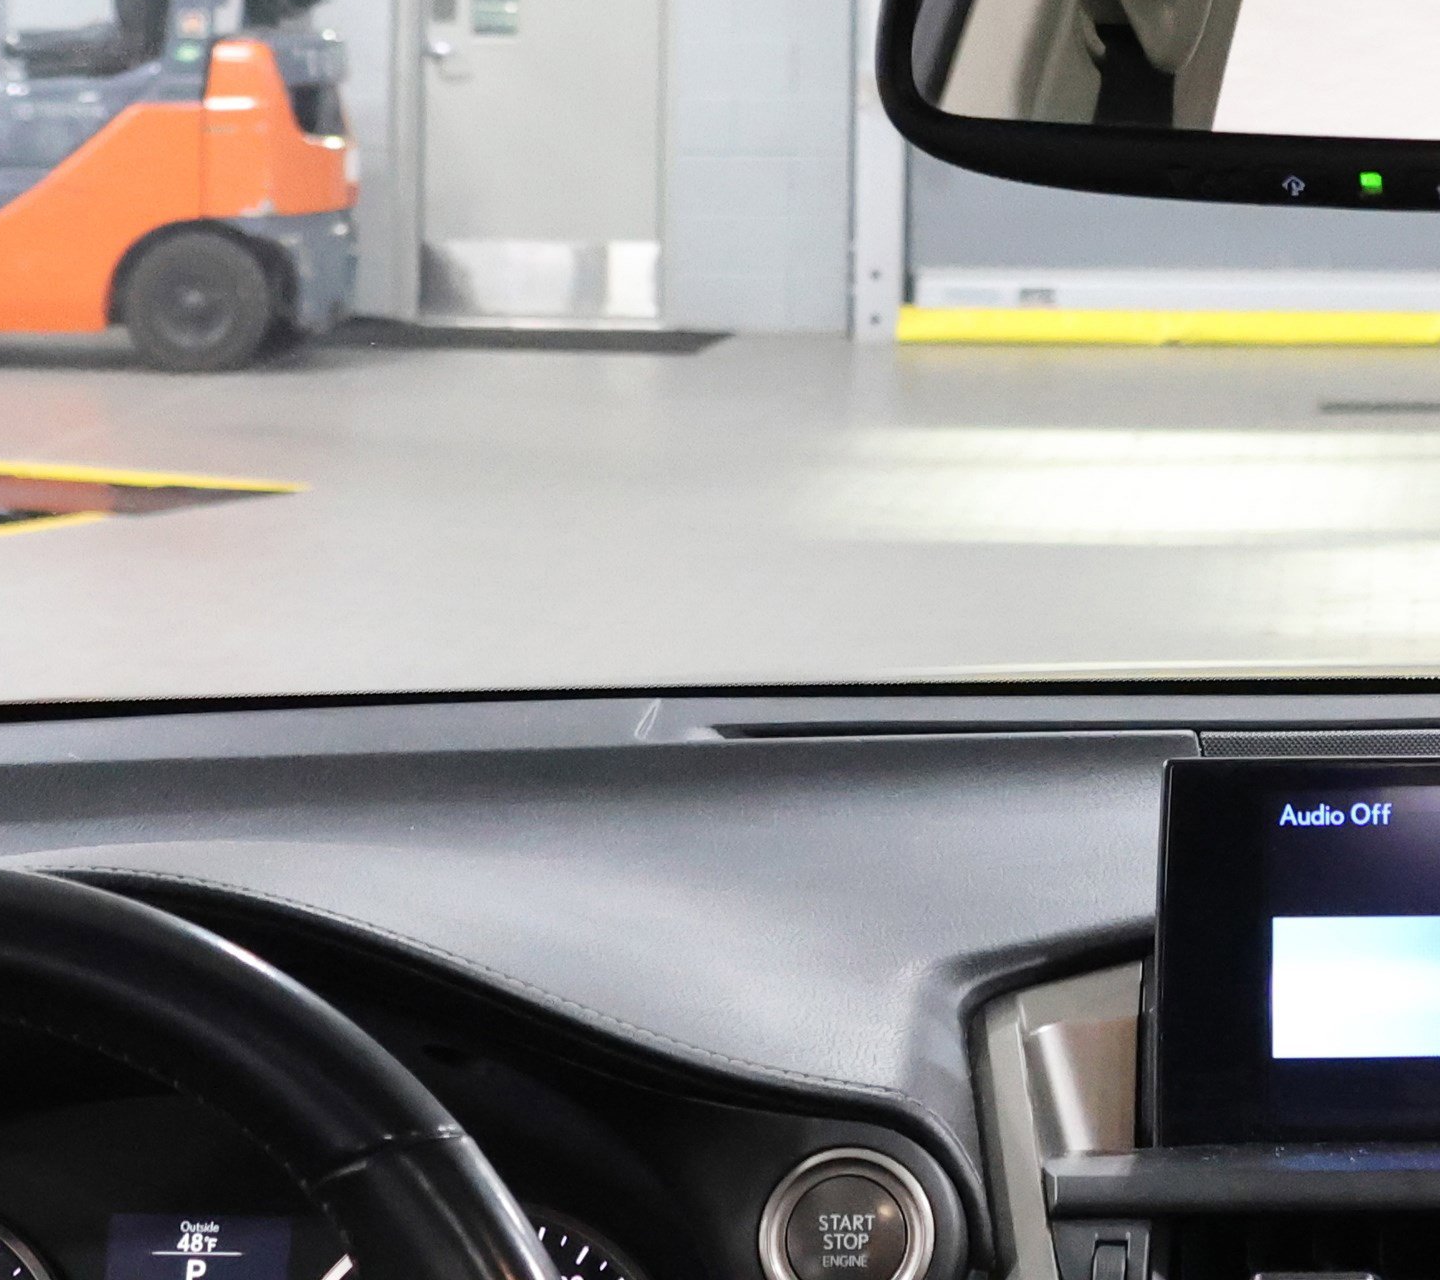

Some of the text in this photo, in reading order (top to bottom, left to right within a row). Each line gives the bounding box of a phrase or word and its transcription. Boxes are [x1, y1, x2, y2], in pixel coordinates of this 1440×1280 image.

[1279, 802, 1392, 826] Audio Off
[179, 1220, 220, 1234] Outside
[818, 1213, 876, 1232] START
[822, 1233, 870, 1251] STOP
[185, 1258, 207, 1280] P
[822, 1254, 869, 1269] ENGINE
